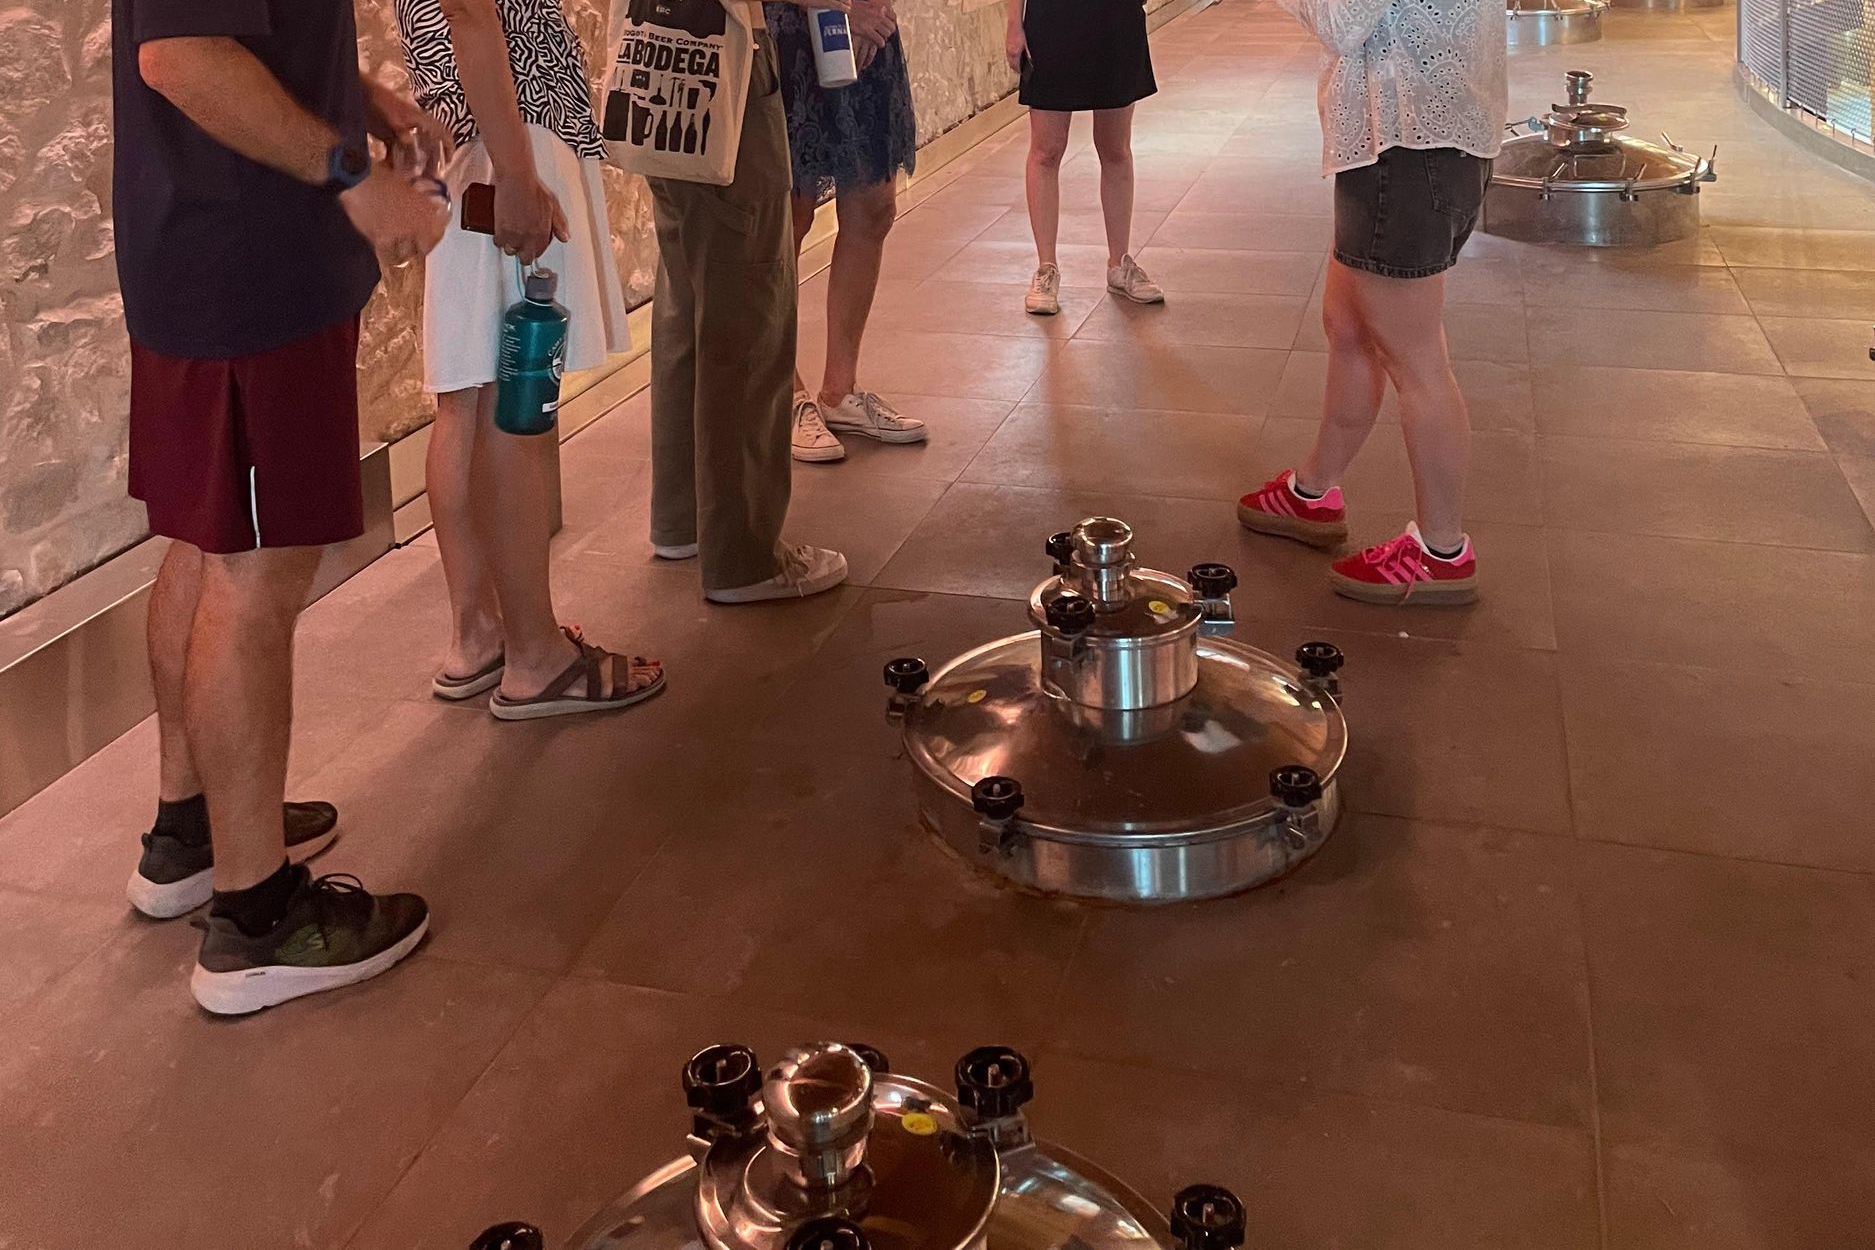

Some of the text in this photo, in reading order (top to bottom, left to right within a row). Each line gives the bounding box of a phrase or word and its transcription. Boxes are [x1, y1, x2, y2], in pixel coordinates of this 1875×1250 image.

[648, 32, 673, 44] BEER
[676, 38, 722, 50] COMPANY
[618, 39, 720, 78] LA BODEGA
